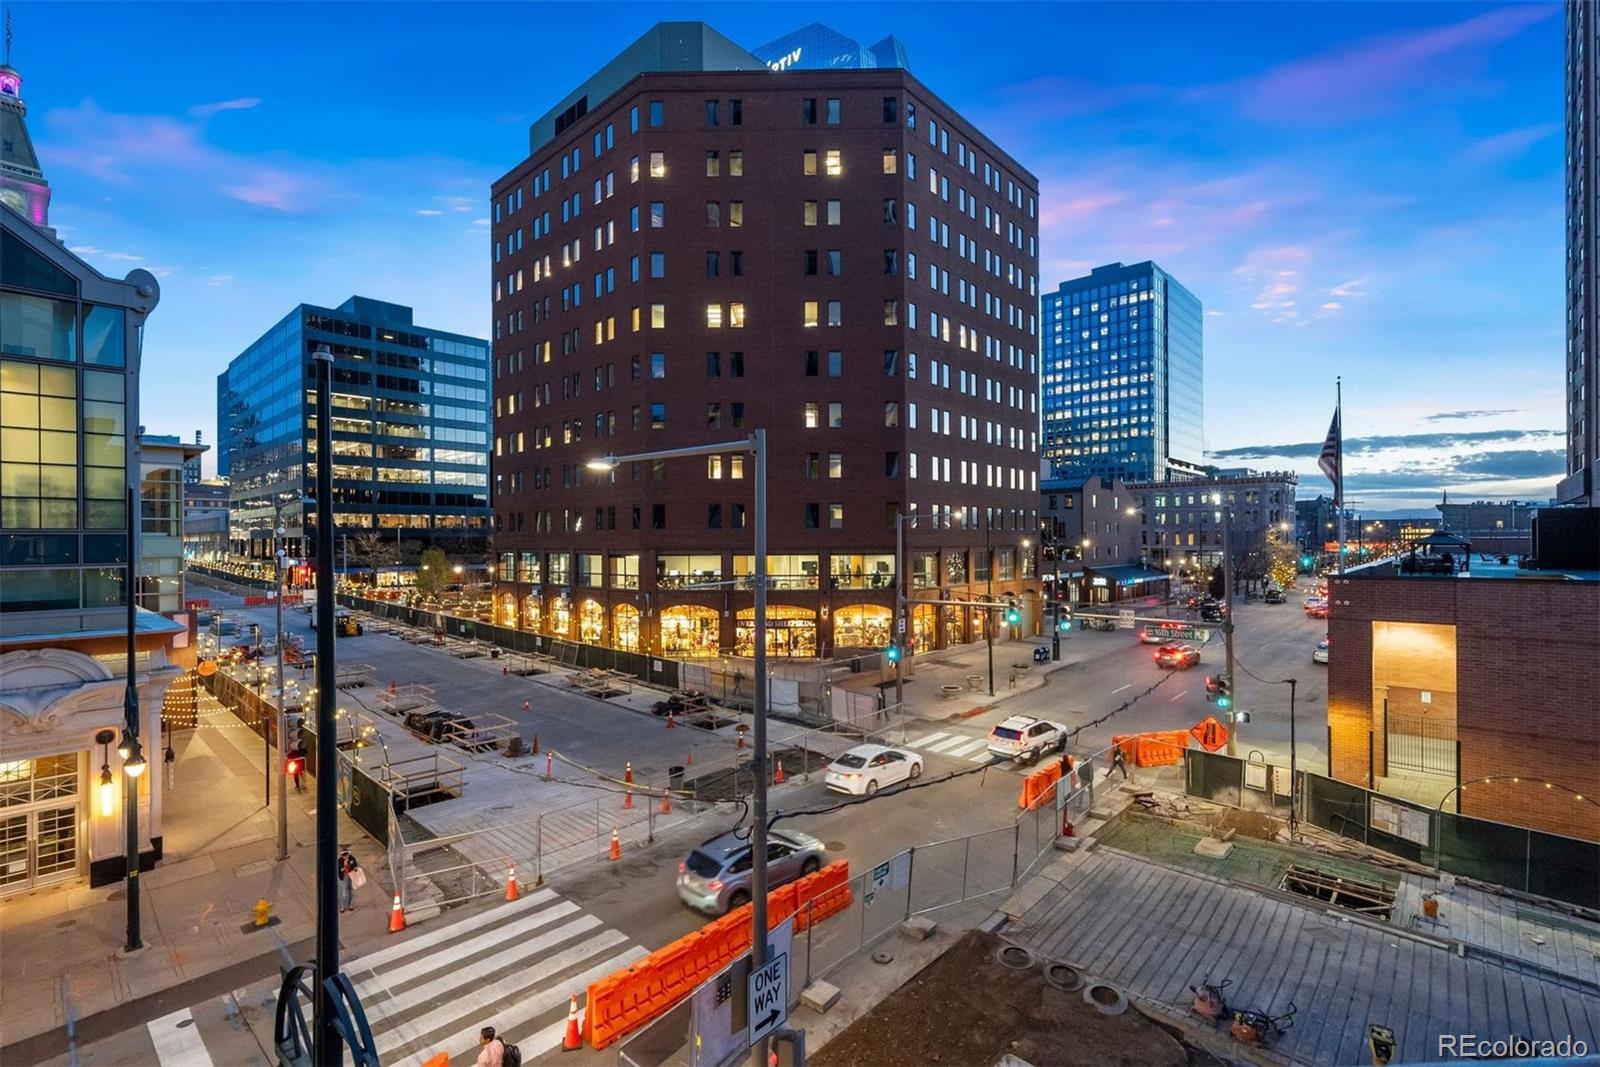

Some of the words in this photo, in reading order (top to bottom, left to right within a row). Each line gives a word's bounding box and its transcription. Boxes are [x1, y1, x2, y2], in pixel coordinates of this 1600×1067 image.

[1154, 628, 1169, 638] 16th
[1170, 628, 1193, 640] Street
[755, 961, 781, 992] ONE
[754, 981, 781, 1015] WAY
